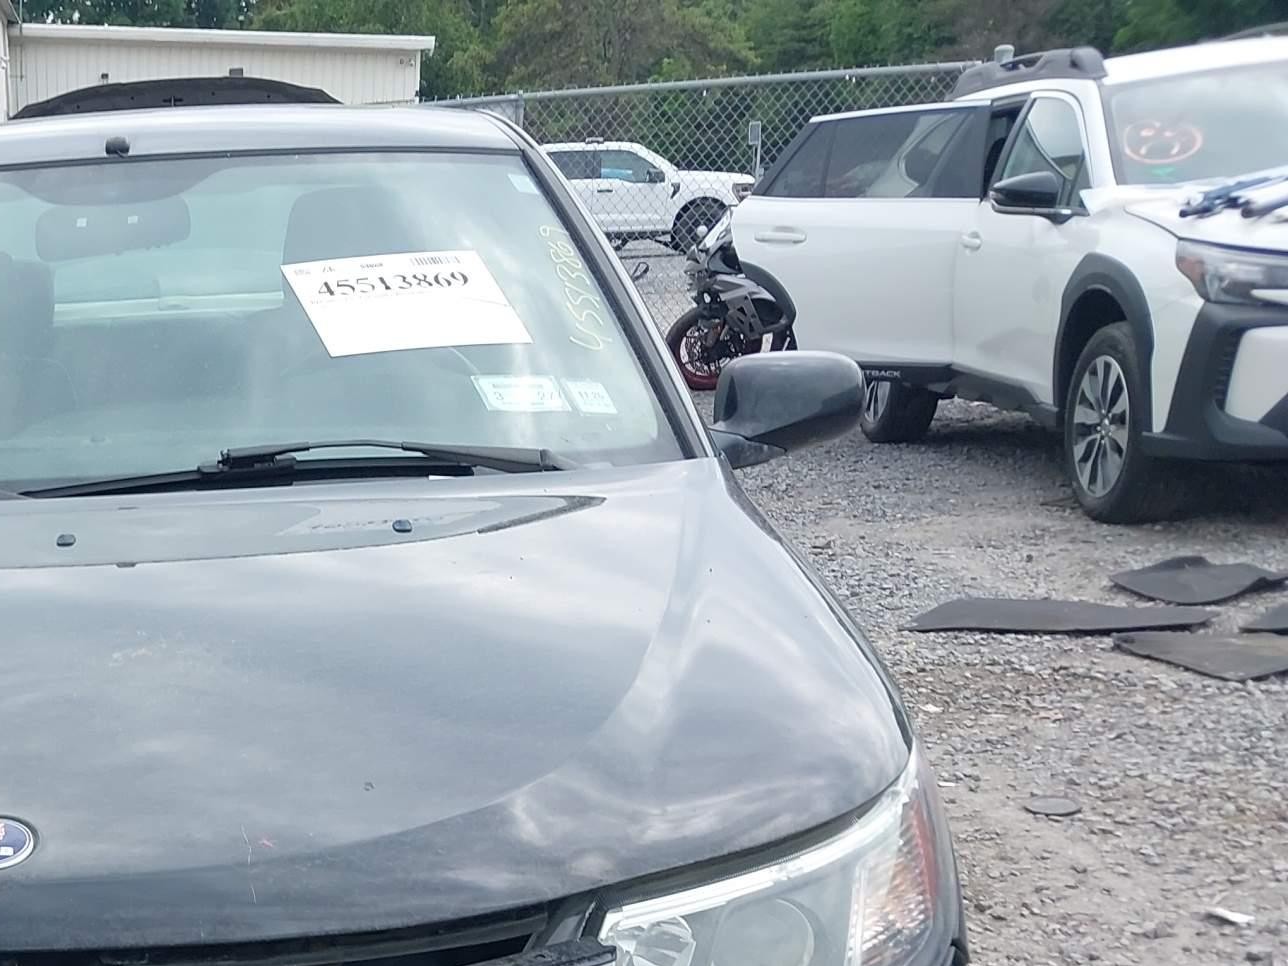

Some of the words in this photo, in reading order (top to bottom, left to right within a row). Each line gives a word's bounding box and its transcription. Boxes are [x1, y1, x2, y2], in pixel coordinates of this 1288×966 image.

[318, 271, 469, 296] 45513869
[540, 225, 612, 350] 45513869
[863, 369, 901, 378] TBACK
